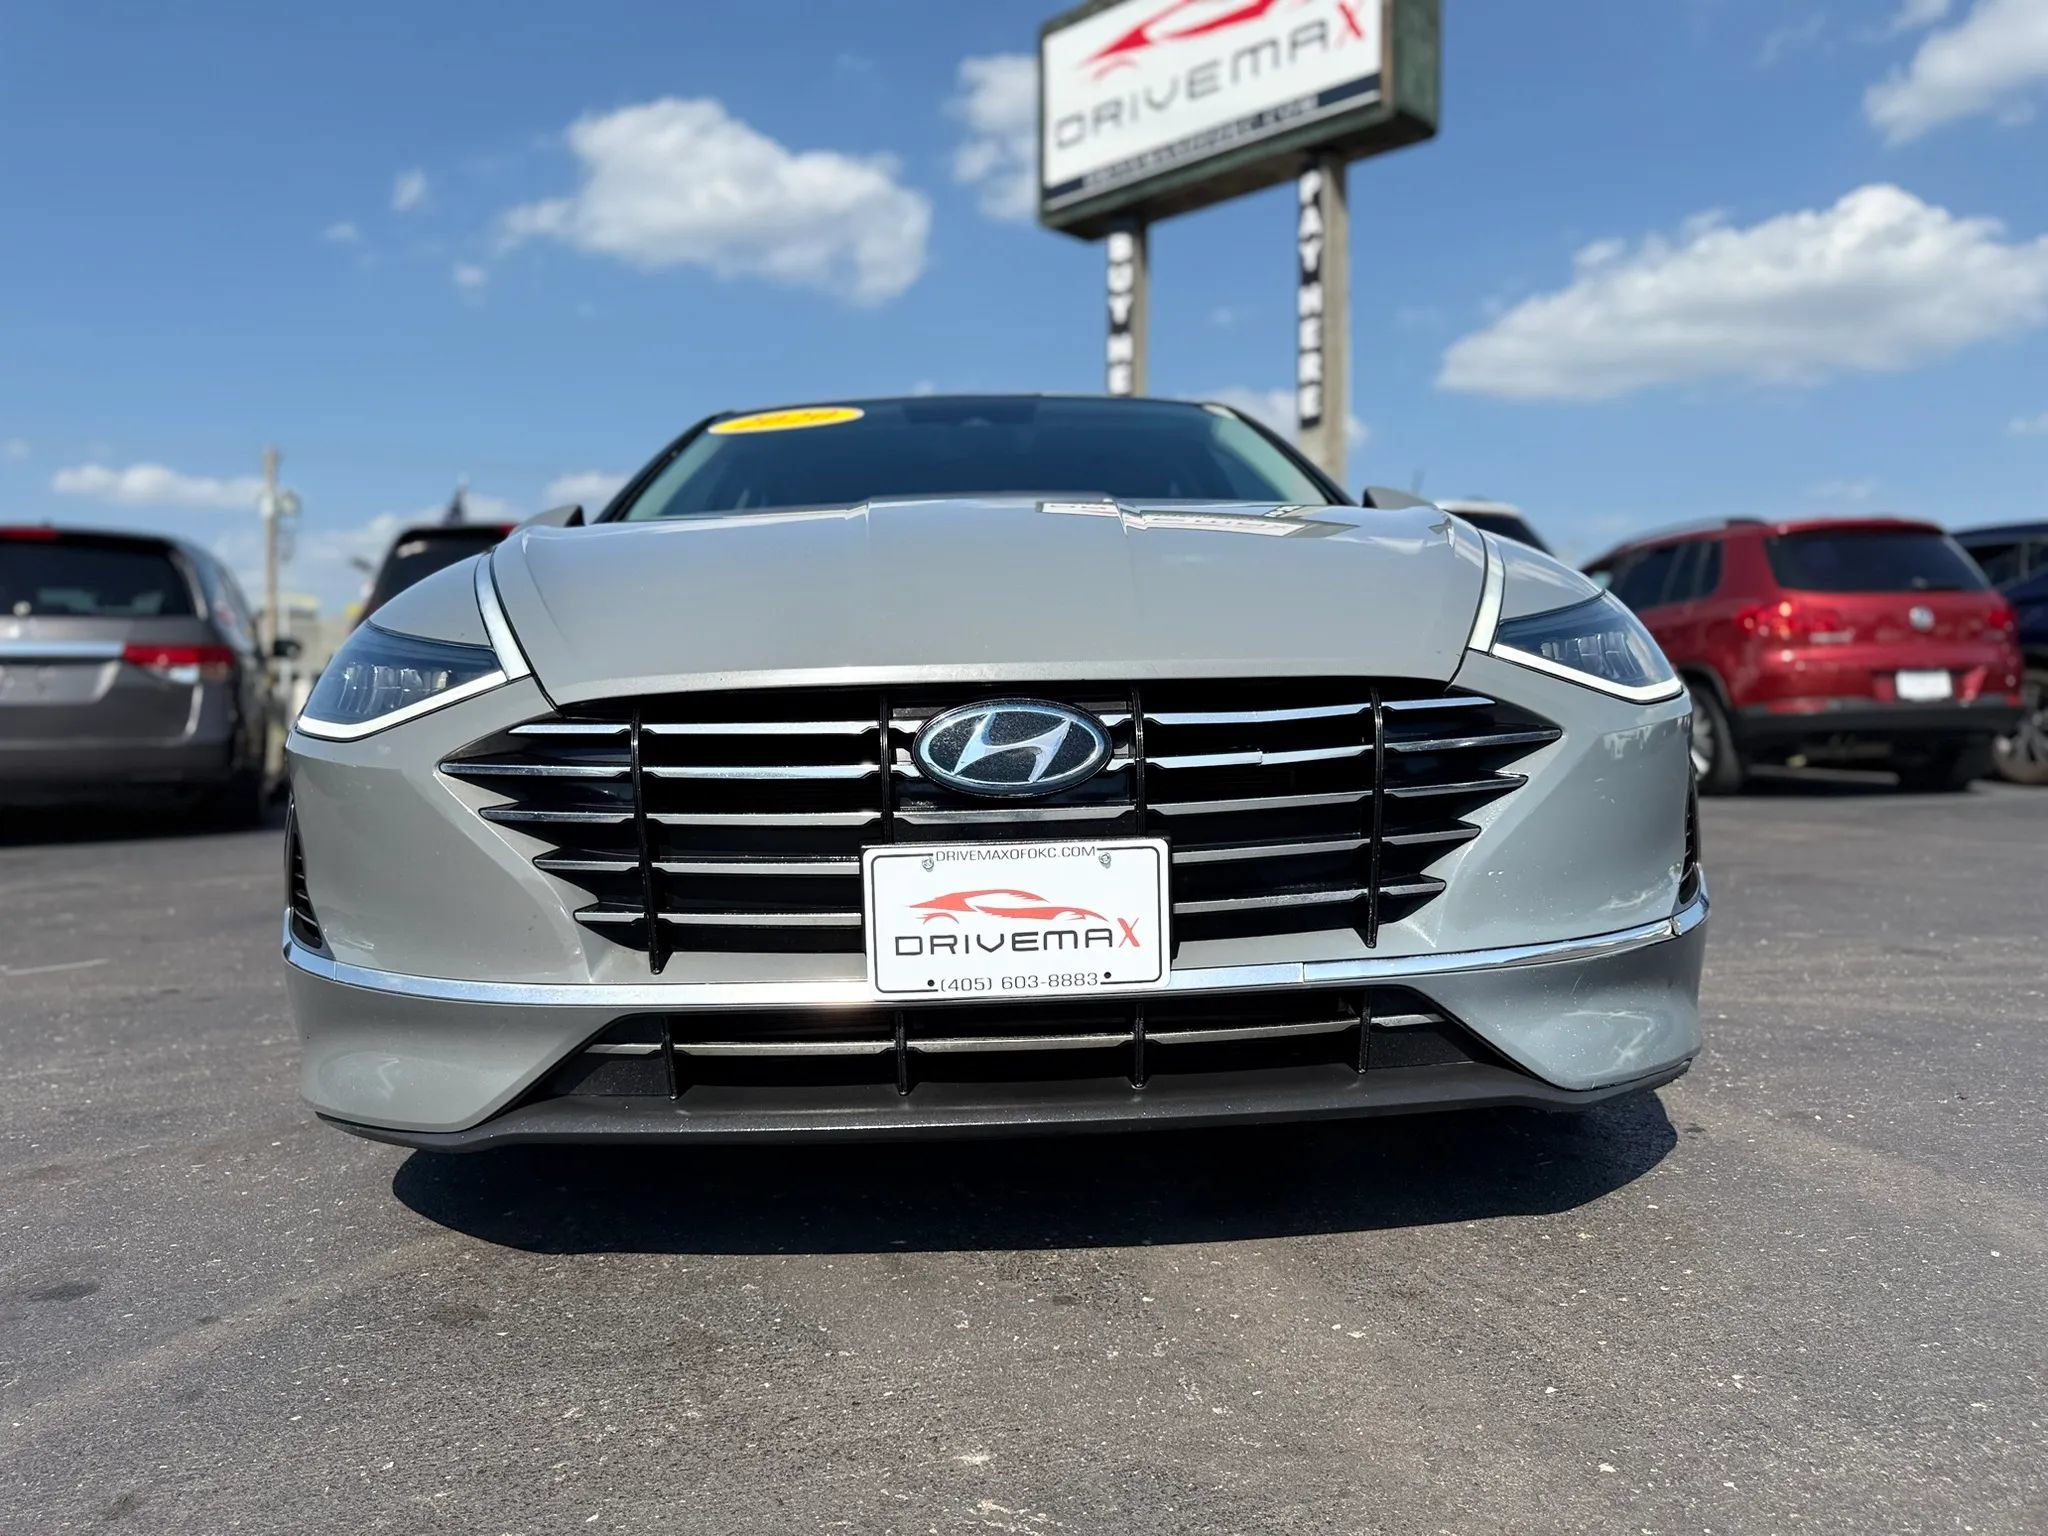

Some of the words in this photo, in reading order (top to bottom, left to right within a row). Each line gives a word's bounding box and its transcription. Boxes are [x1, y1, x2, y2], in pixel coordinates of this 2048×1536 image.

[1054, 0, 1364, 150] DRIVEMAX
[935, 846, 1096, 862] DRIVEMAXOFOKC.COM
[894, 917, 1141, 957] DRIVEMAX
[940, 976, 993, 992] (405)
[1001, 973, 1099, 989] 603-8883
